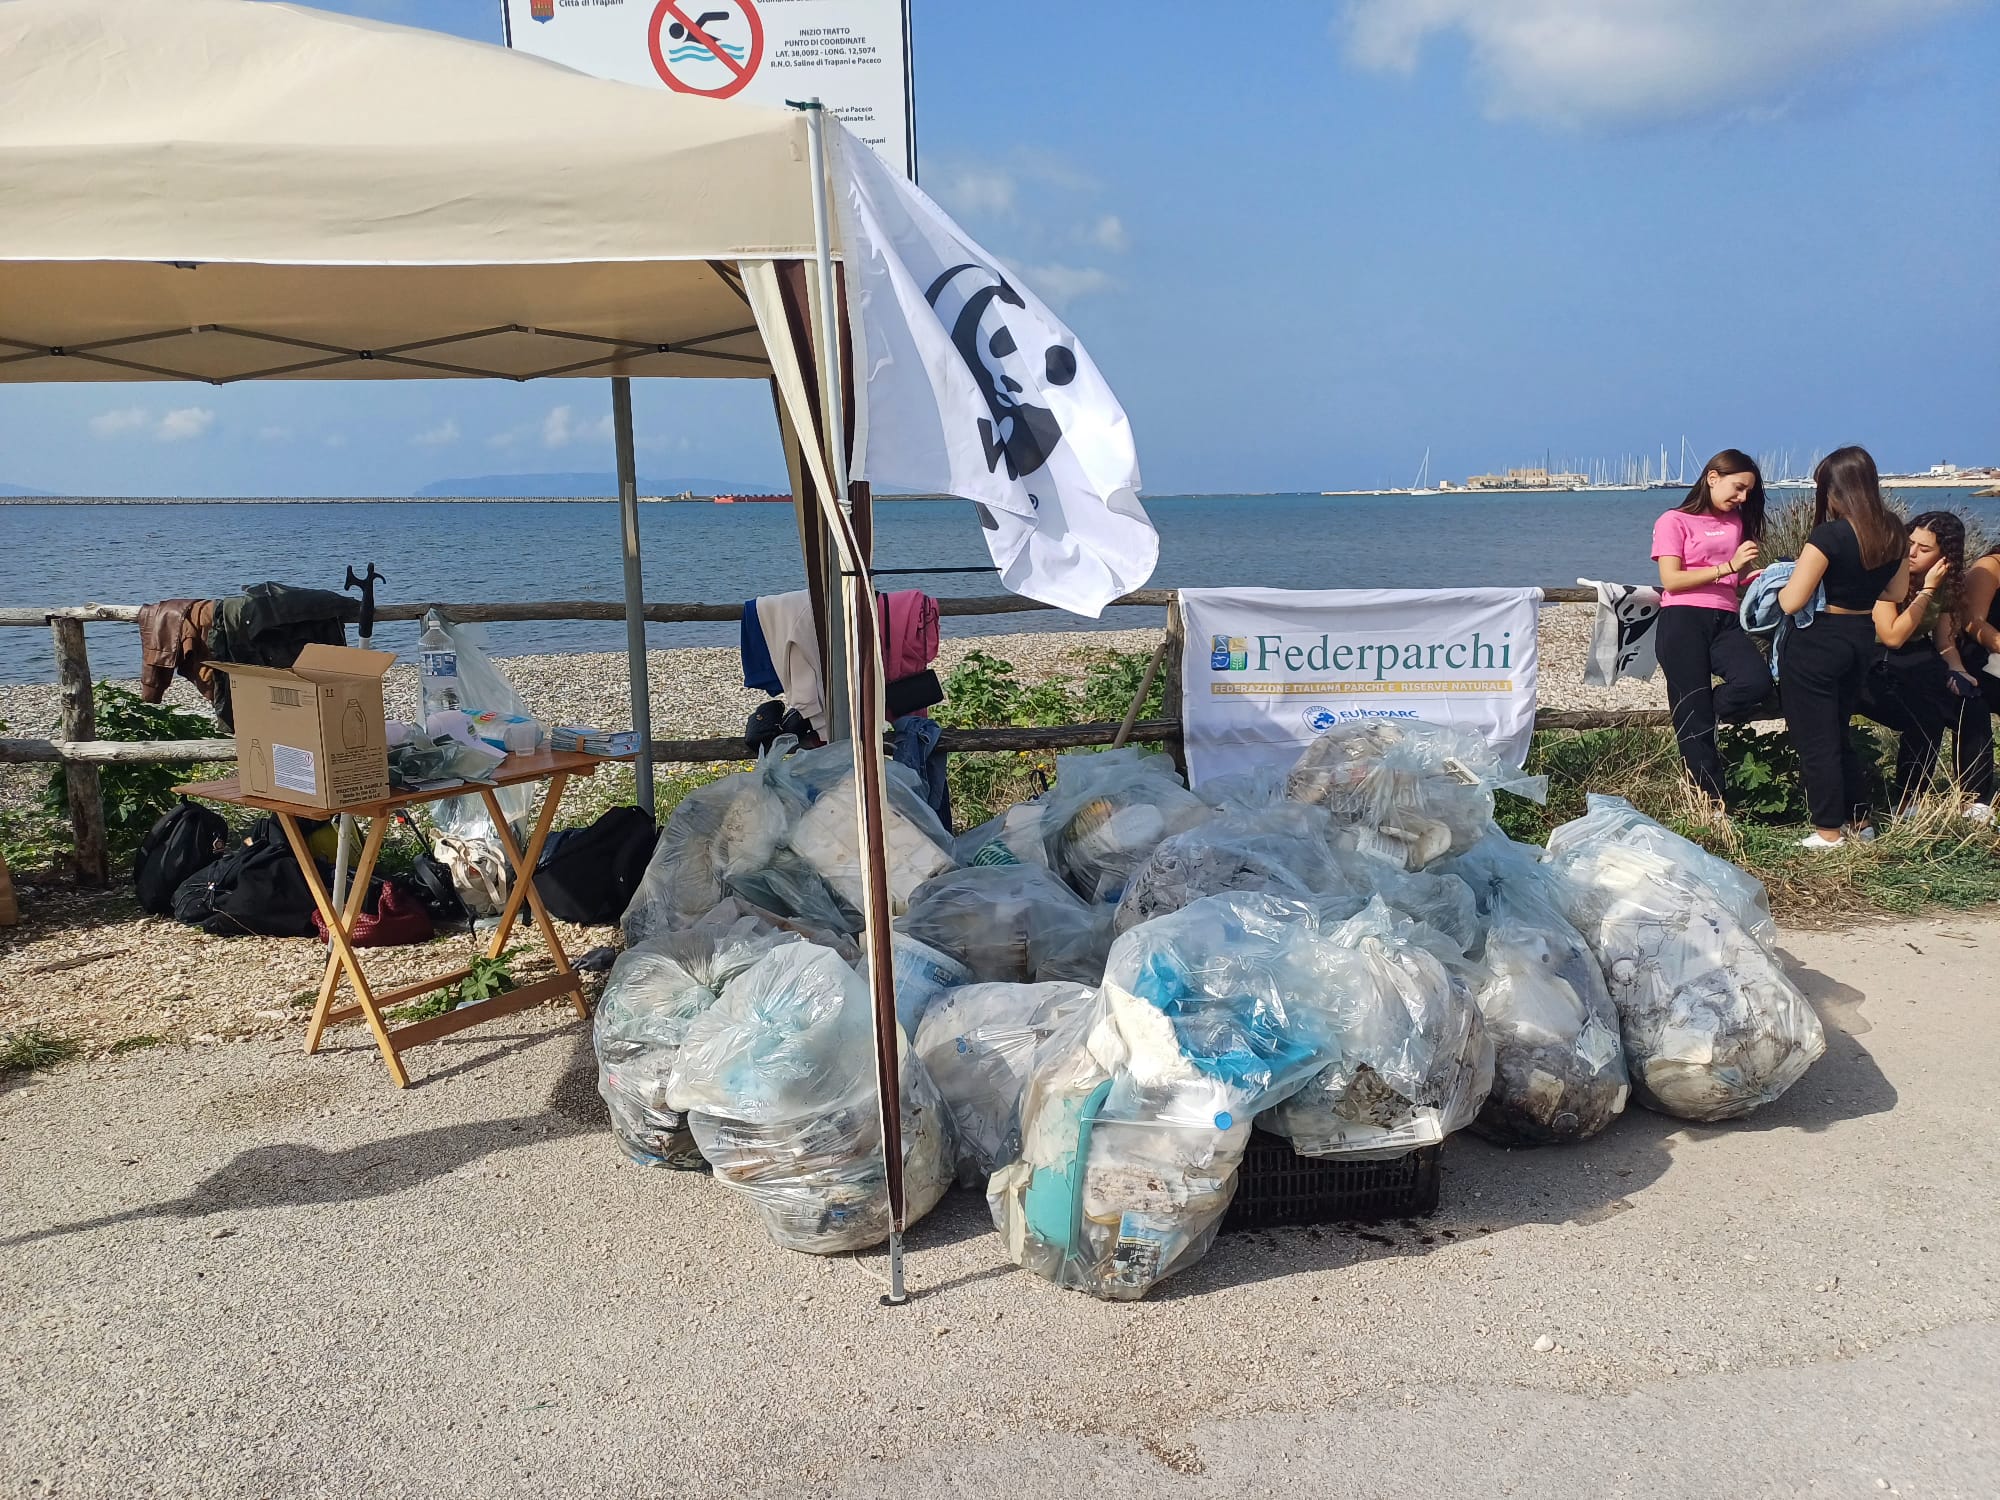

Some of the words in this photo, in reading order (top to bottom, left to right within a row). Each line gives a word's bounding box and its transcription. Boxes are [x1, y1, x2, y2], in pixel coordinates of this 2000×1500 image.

[822, 27, 850, 35] TRATTO
[819, 37, 866, 45] COORDINATE
[775, 50, 790, 58] LAT.
[824, 48, 847, 56] LONG.
[849, 46, 876, 55] 12,5074
[793, 59, 814, 67] Saline
[815, 58, 823, 66] di
[824, 58, 851, 67] Trapani
[1253, 632, 1513, 681] Federparchi
[1214, 684, 1290, 693] FEDERAZIONE
[1293, 683, 1340, 692] ITALIANA
[1344, 683, 1385, 692] PARCHI
[1388, 683, 1396, 691] E
[1401, 682, 1448, 691] RISERVE
[1451, 681, 1509, 691] NATURALI
[1340, 709, 1419, 718] EUROPARC
